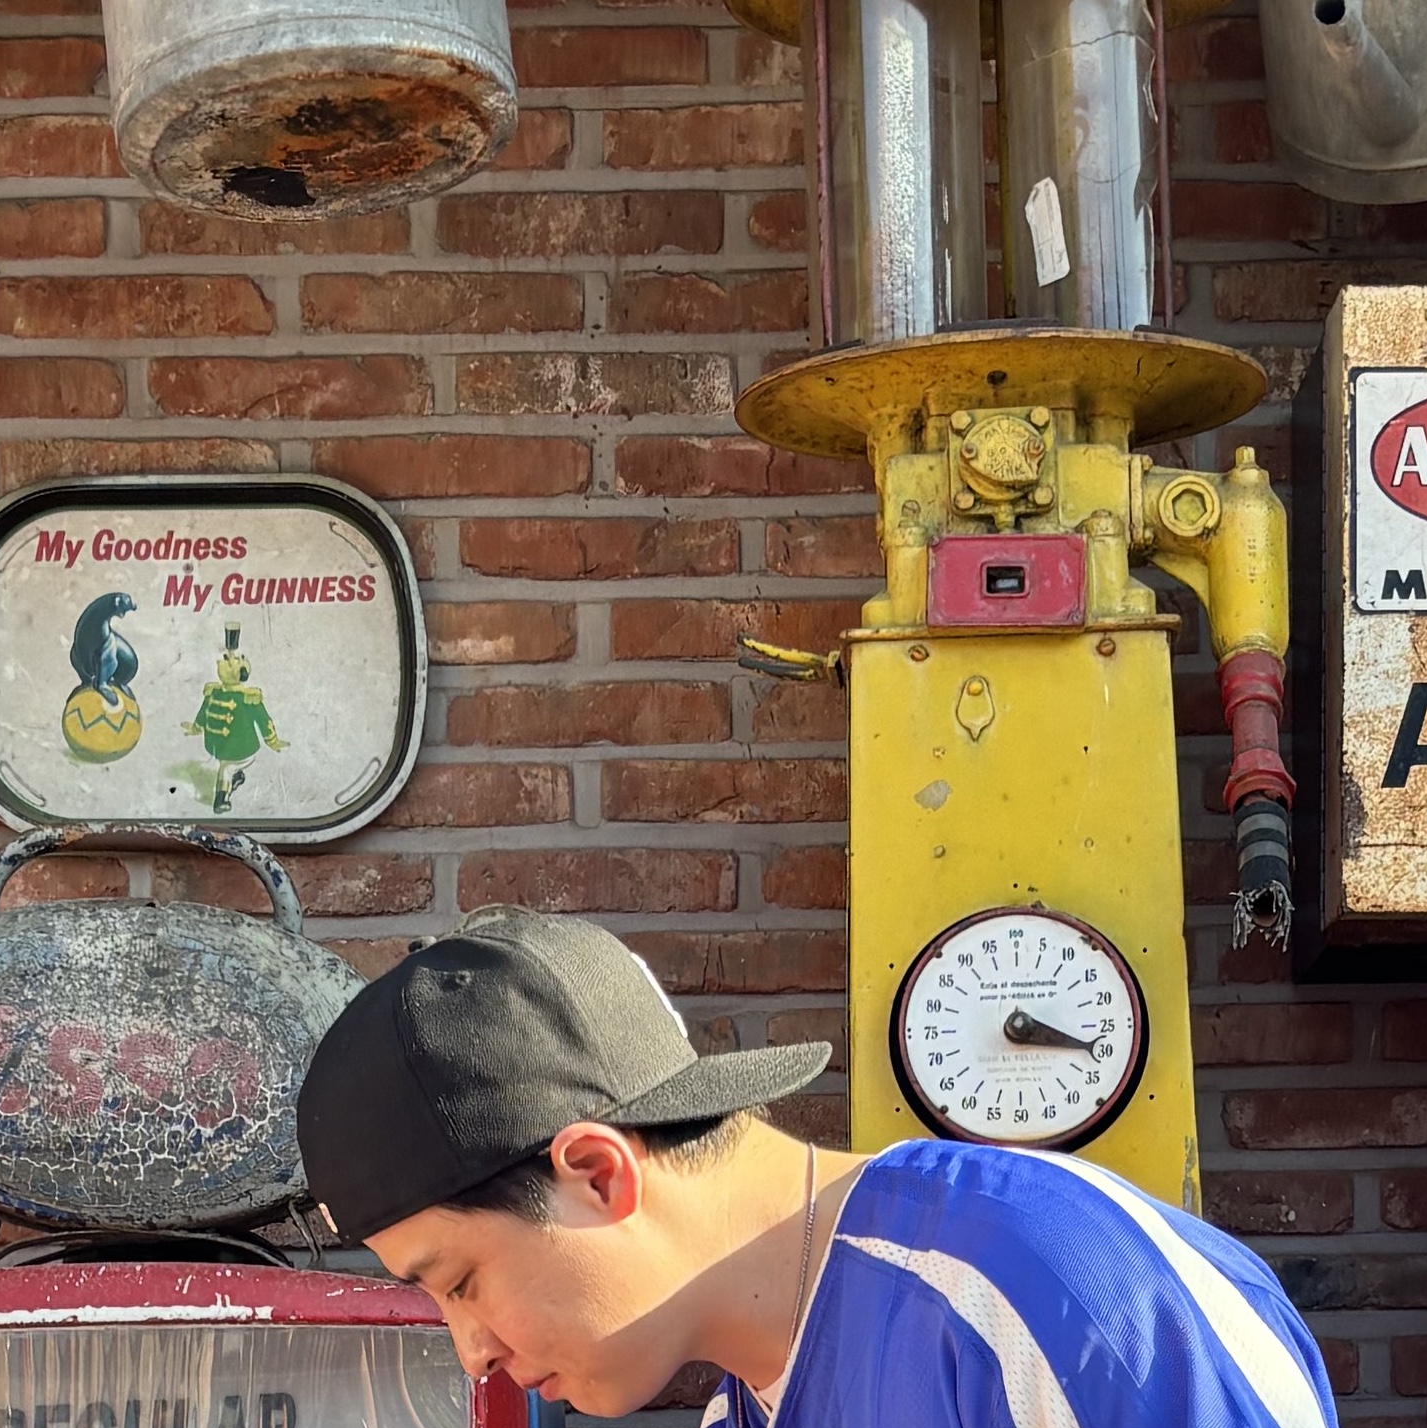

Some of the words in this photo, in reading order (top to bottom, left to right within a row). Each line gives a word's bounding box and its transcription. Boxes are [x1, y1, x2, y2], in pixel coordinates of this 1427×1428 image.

[35, 530, 83, 568] My
[92, 529, 248, 562] Goodness
[163, 574, 213, 612] My
[220, 572, 376, 605] GUINNESS
[982, 940, 997, 954] 95
[1038, 938, 1047, 951] 5
[957, 953, 973, 968] 90
[1061, 947, 1075, 961] 10
[939, 974, 954, 988] 85
[1084, 969, 1098, 982] 15
[1095, 992, 1112, 1005] 20
[926, 999, 941, 1013] 80
[924, 1026, 939, 1040] 75
[1099, 1020, 1115, 1033] 25
[1097, 1044, 1113, 1058] 30
[928, 1052, 943, 1066] 70
[939, 1077, 955, 1091] 65
[1085, 1071, 1100, 1085] 35
[961, 1096, 977, 1110] 60
[1064, 1090, 1080, 1104] 40
[987, 1107, 1002, 1120] 55
[1013, 1109, 1029, 1123] 50
[1041, 1105, 1057, 1119] 45
